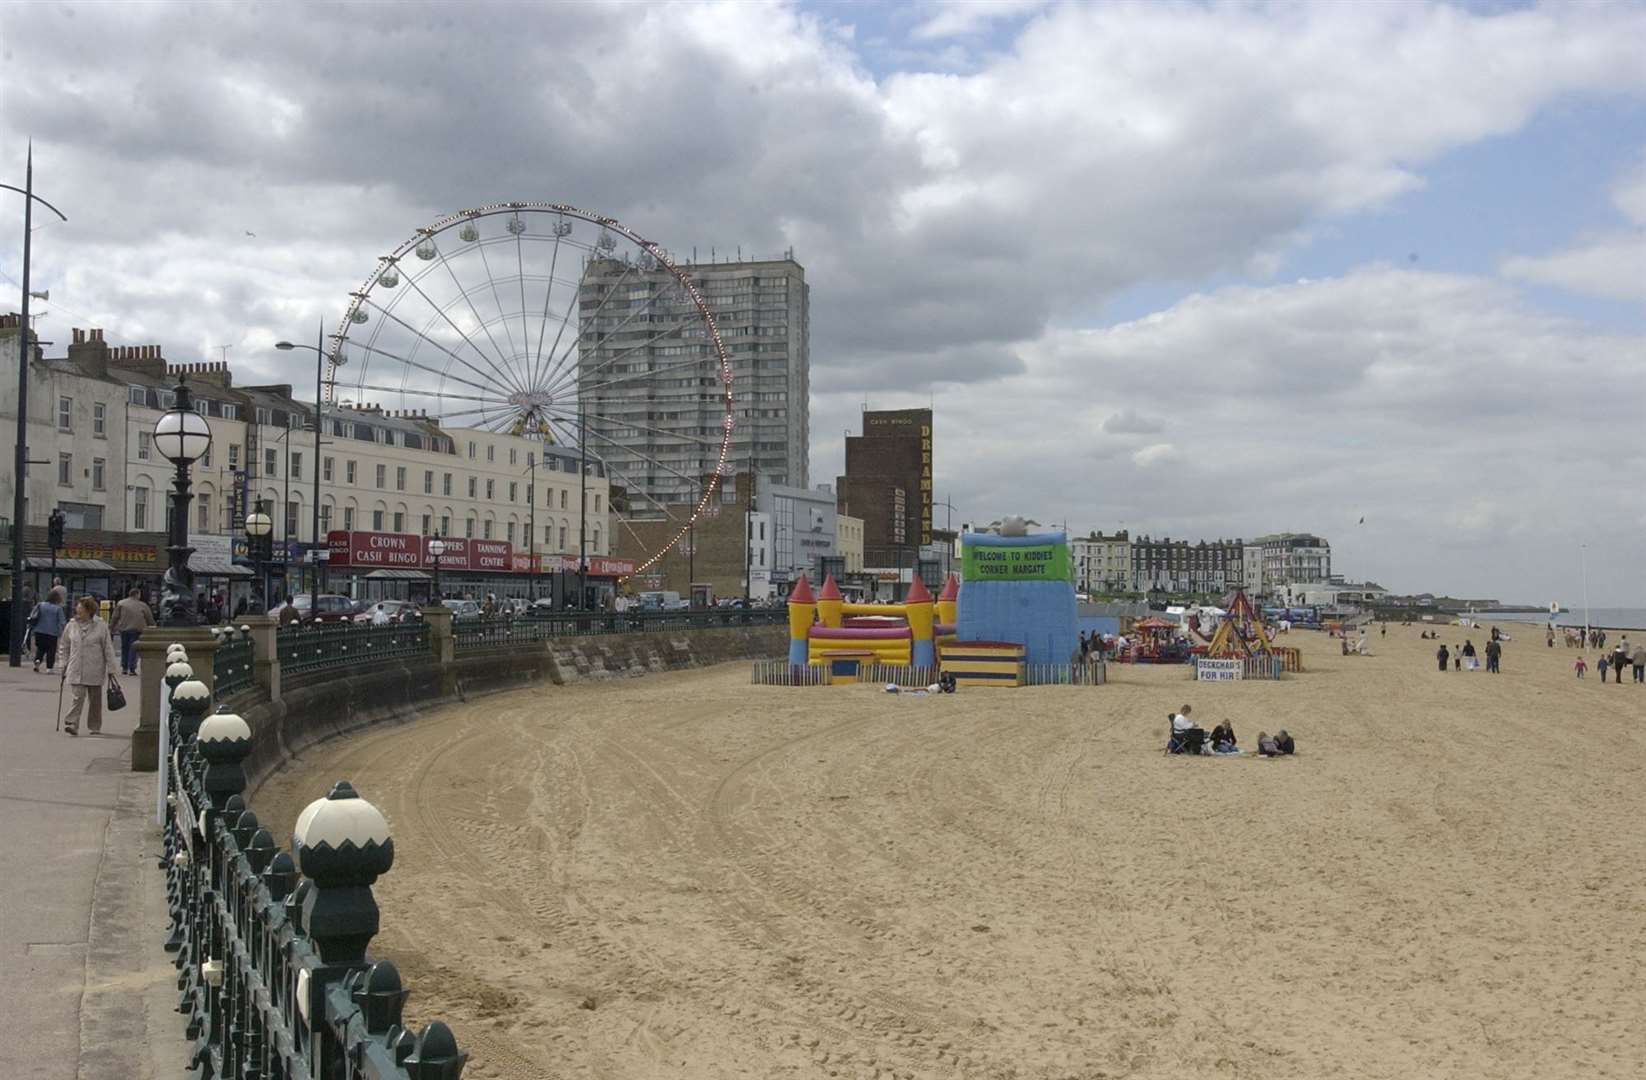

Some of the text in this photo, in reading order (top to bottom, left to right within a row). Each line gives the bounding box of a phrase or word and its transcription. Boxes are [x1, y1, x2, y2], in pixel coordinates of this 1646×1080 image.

[920, 425, 931, 545] DREAMLAND
[370, 536, 406, 549] CROWN
[112, 545, 157, 561] MINE
[477, 543, 507, 554] TANNING
[356, 550, 417, 563] CASH BINGO
[480, 556, 504, 567] CENTRE
[973, 551, 1053, 561] WELCOME TO KIDDIES
[980, 564, 1046, 574] CORNER MARGATE
[1201, 671, 1217, 680] FOR
